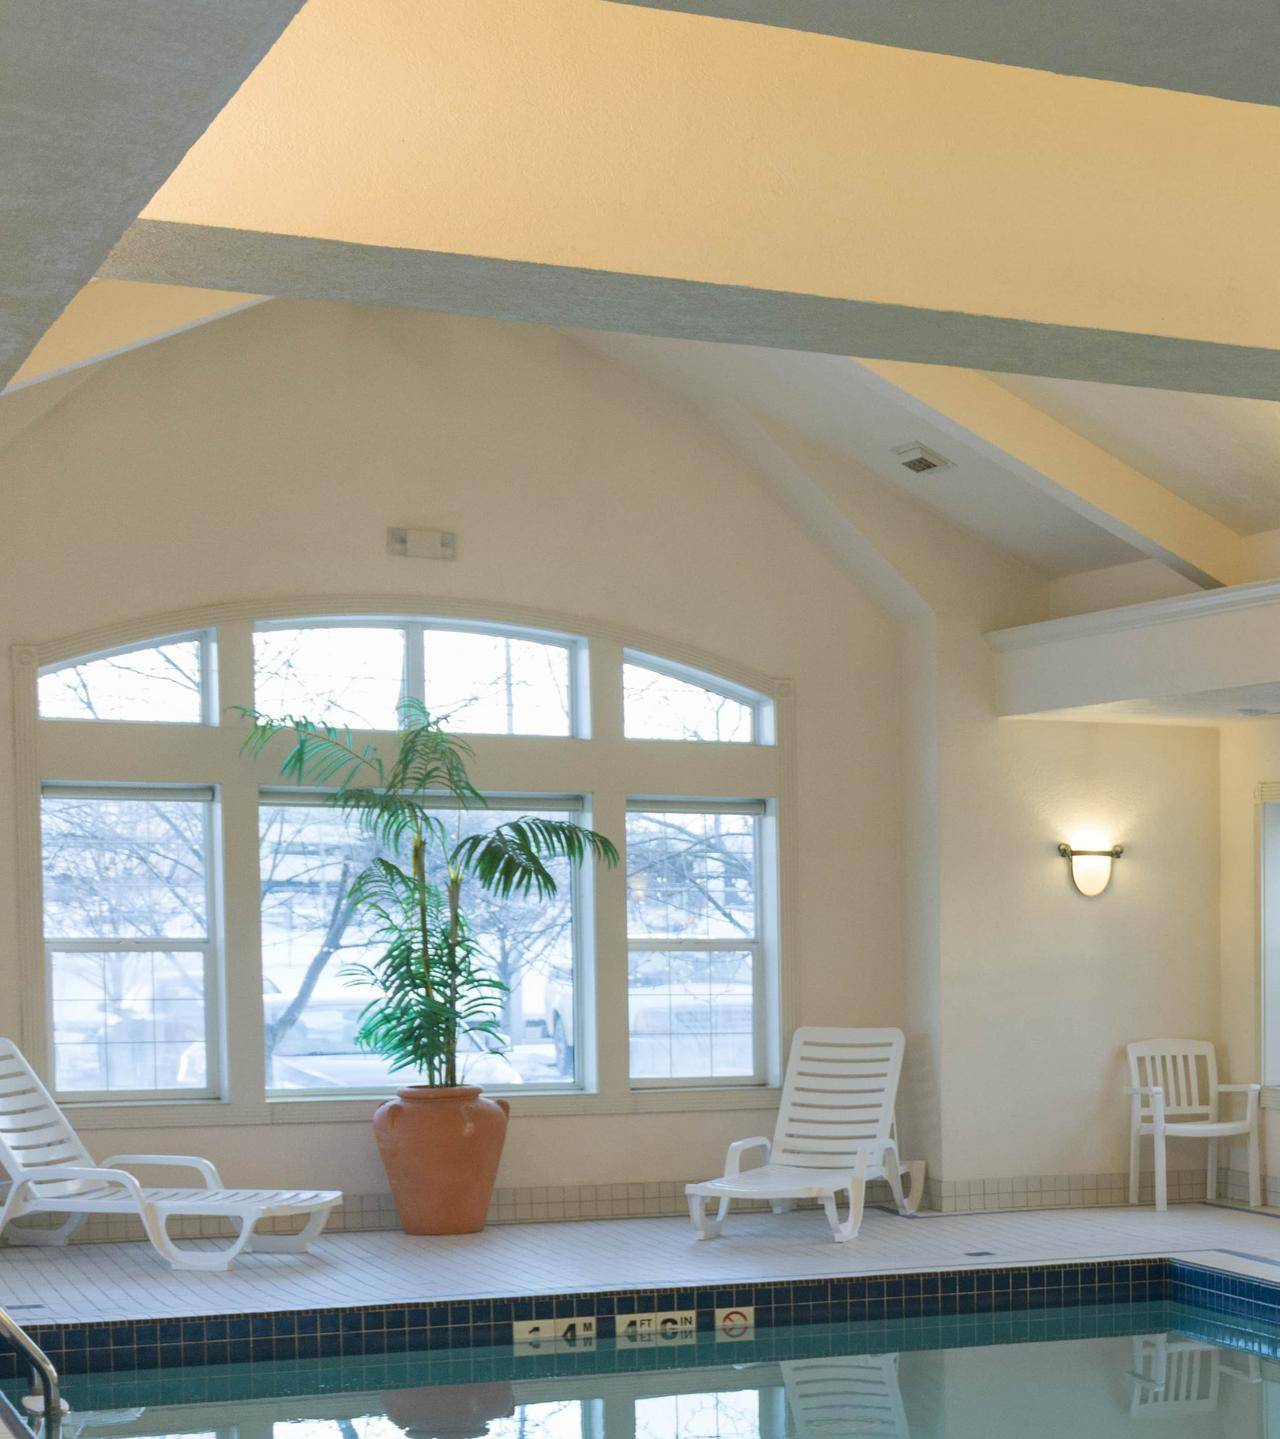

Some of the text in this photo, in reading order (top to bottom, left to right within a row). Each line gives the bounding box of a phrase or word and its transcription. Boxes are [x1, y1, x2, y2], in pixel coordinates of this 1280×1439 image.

[583, 1322, 593, 1332] M
[640, 1318, 653, 1328] FT
[680, 1316, 693, 1327] IN
